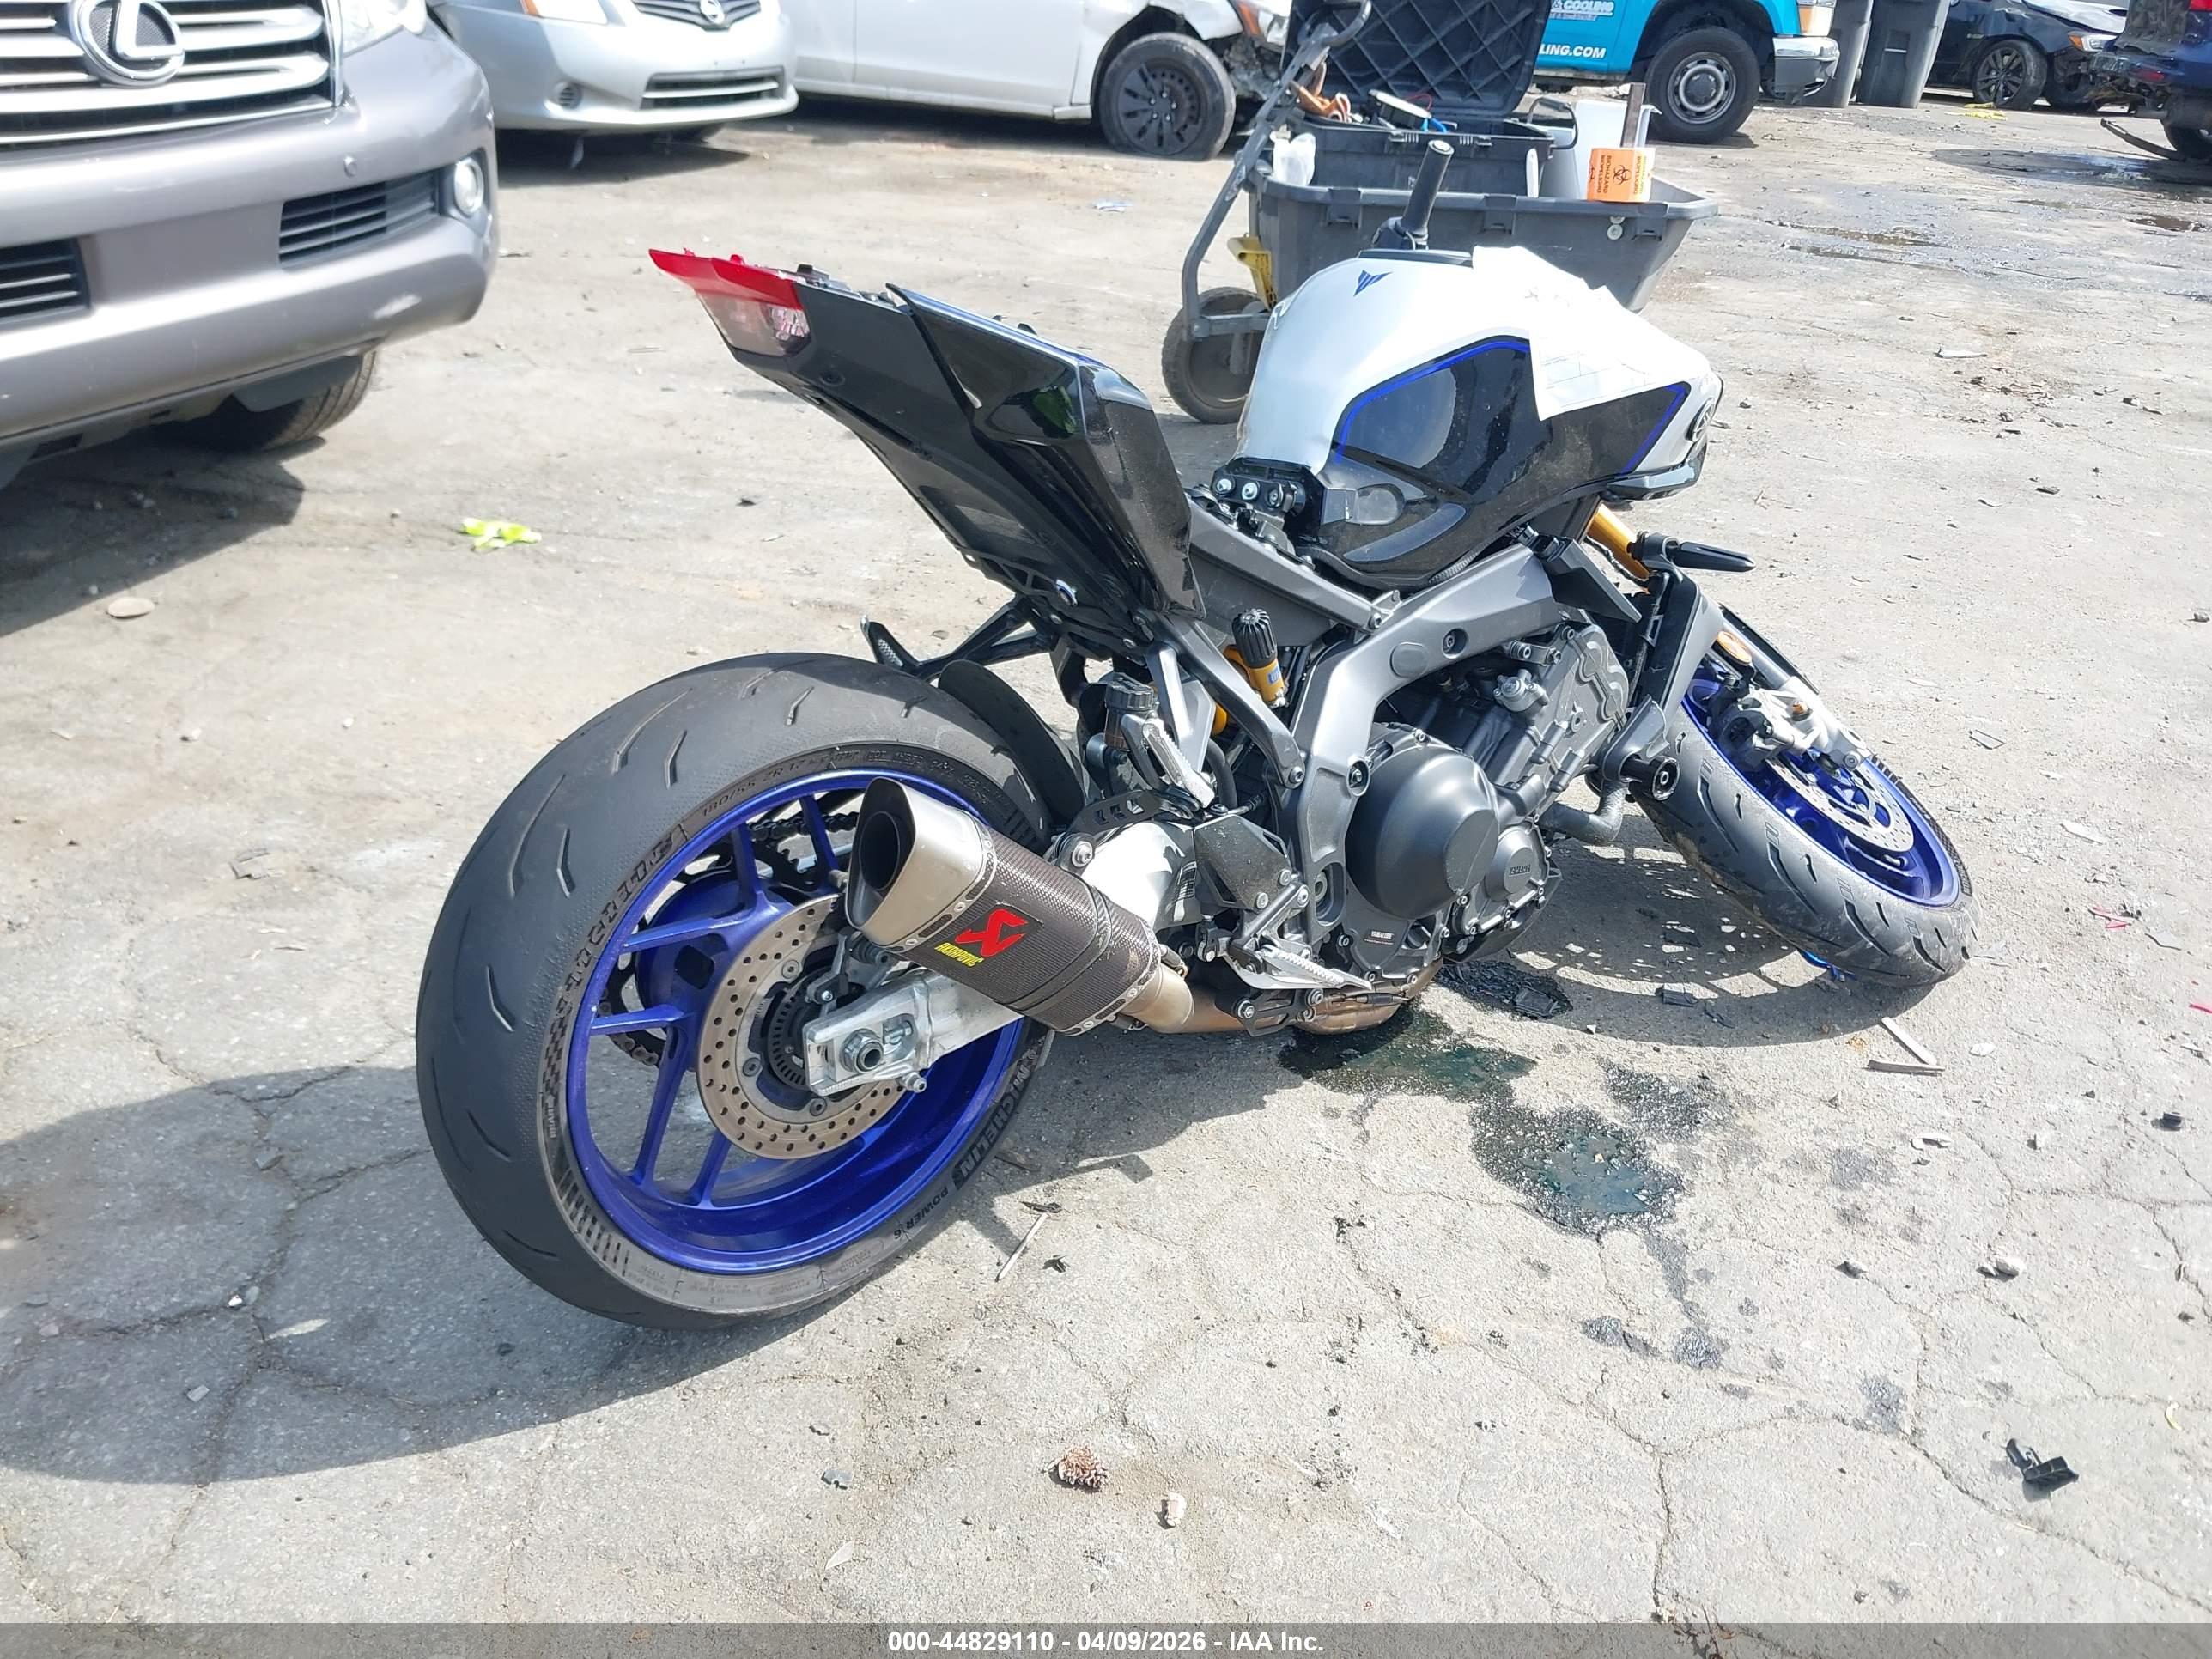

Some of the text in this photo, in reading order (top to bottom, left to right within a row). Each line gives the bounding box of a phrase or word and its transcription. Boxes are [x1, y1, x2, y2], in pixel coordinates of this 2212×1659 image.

[1564, 0, 1614, 12] COOLING
[1597, 155, 1606, 193] BIOPELIGRO
[1603, 155, 1612, 193] BIOHAZARD
[894, 1063, 1032, 1240] MICHELIN POWER 6
